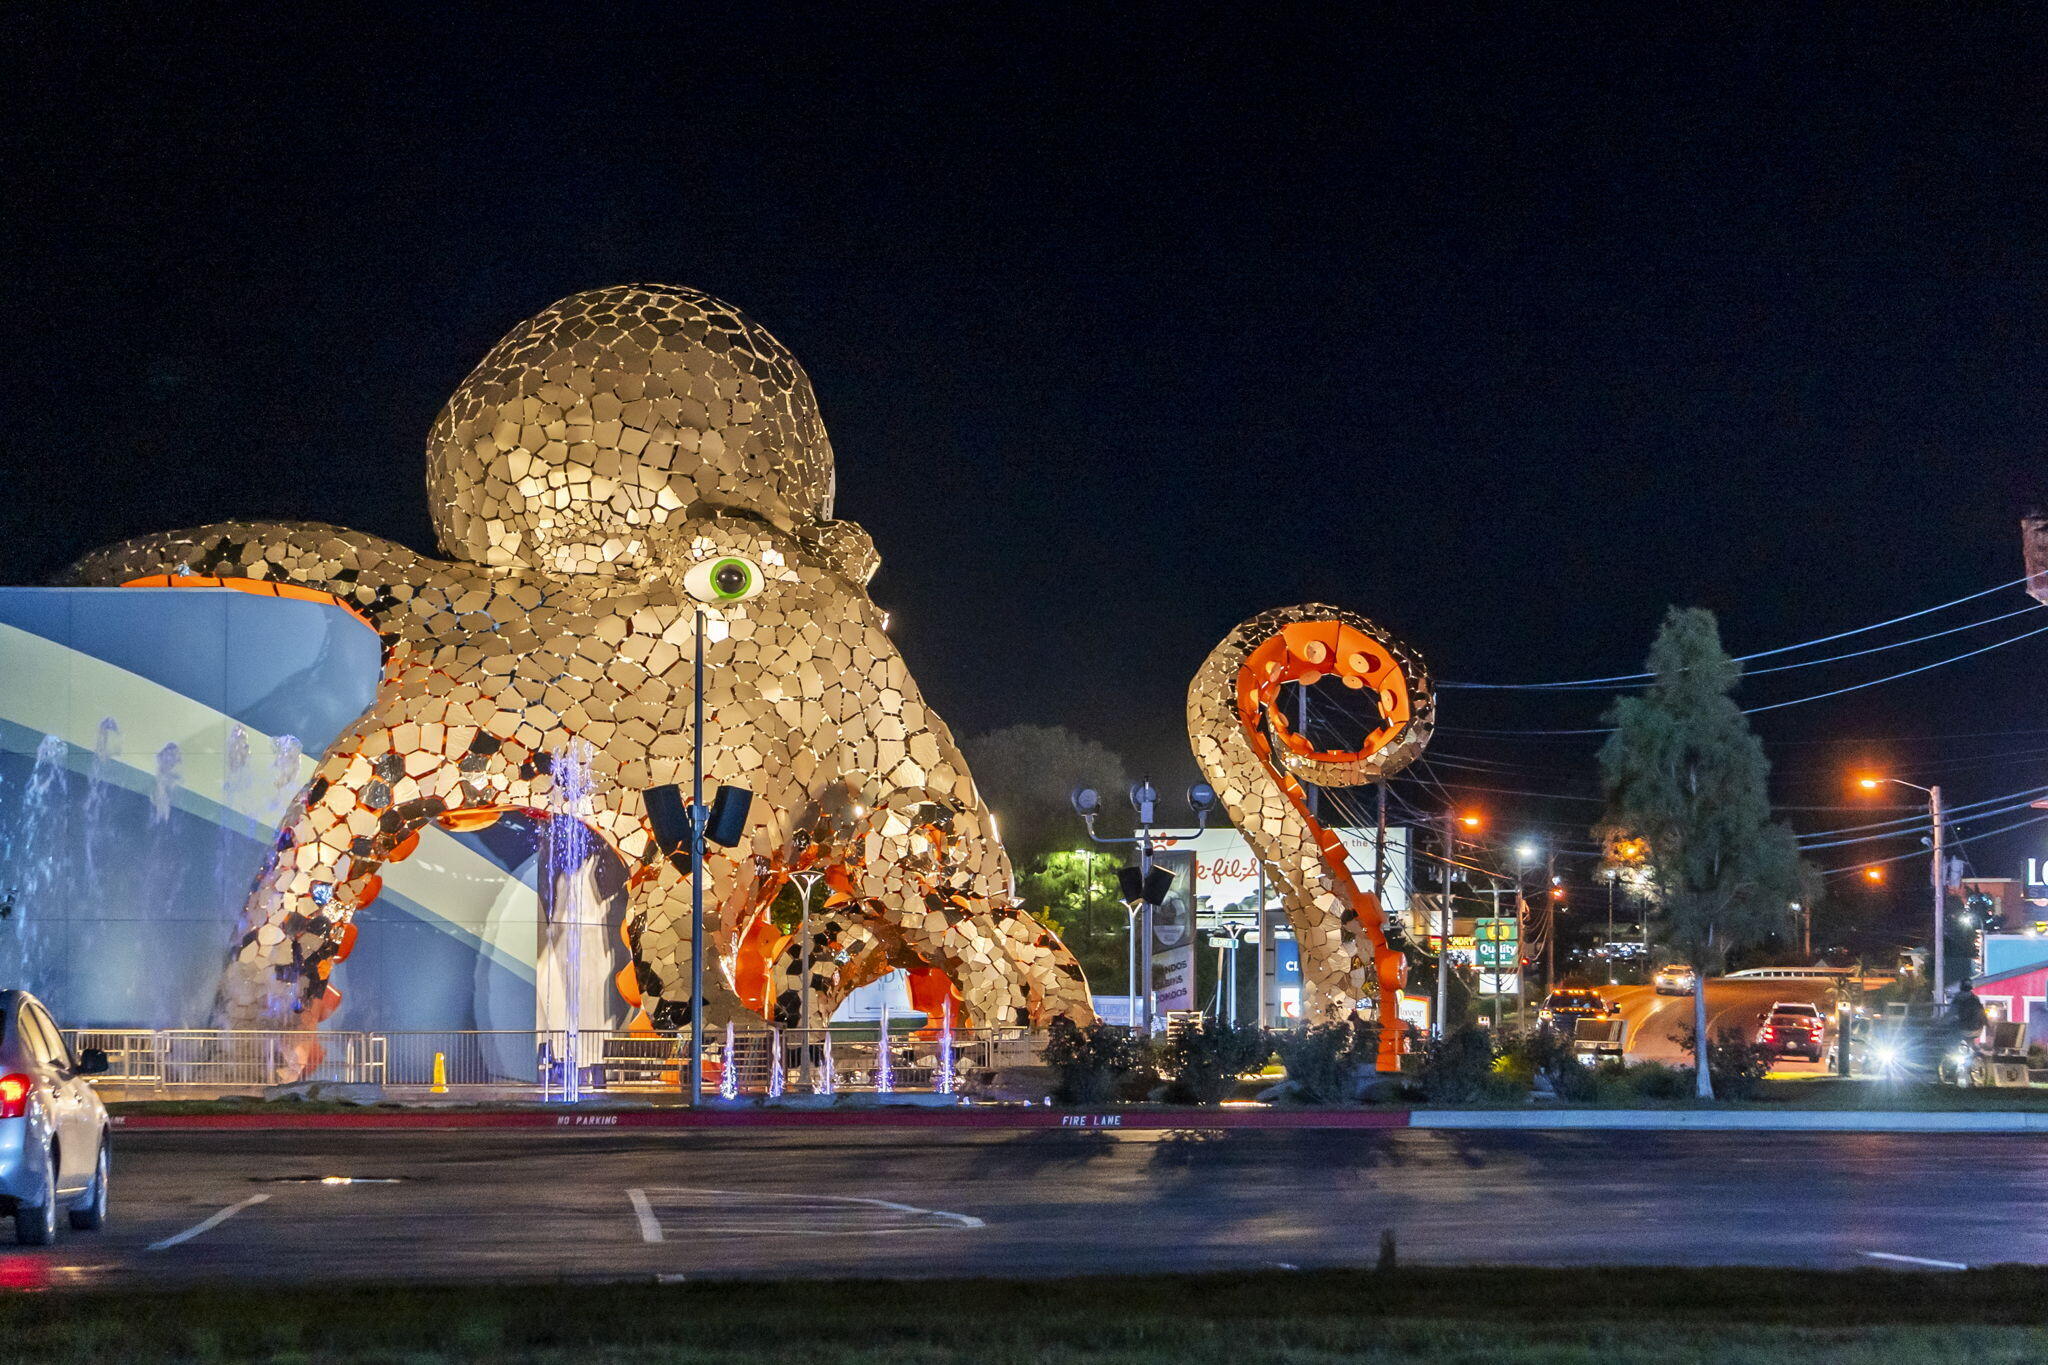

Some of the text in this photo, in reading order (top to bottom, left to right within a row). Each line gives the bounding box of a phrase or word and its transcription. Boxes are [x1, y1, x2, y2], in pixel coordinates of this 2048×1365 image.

[1479, 943, 1517, 955] Qulity
[557, 1115, 618, 1125] NO PARKING
[1062, 1115, 1121, 1126] FIRE LANE
